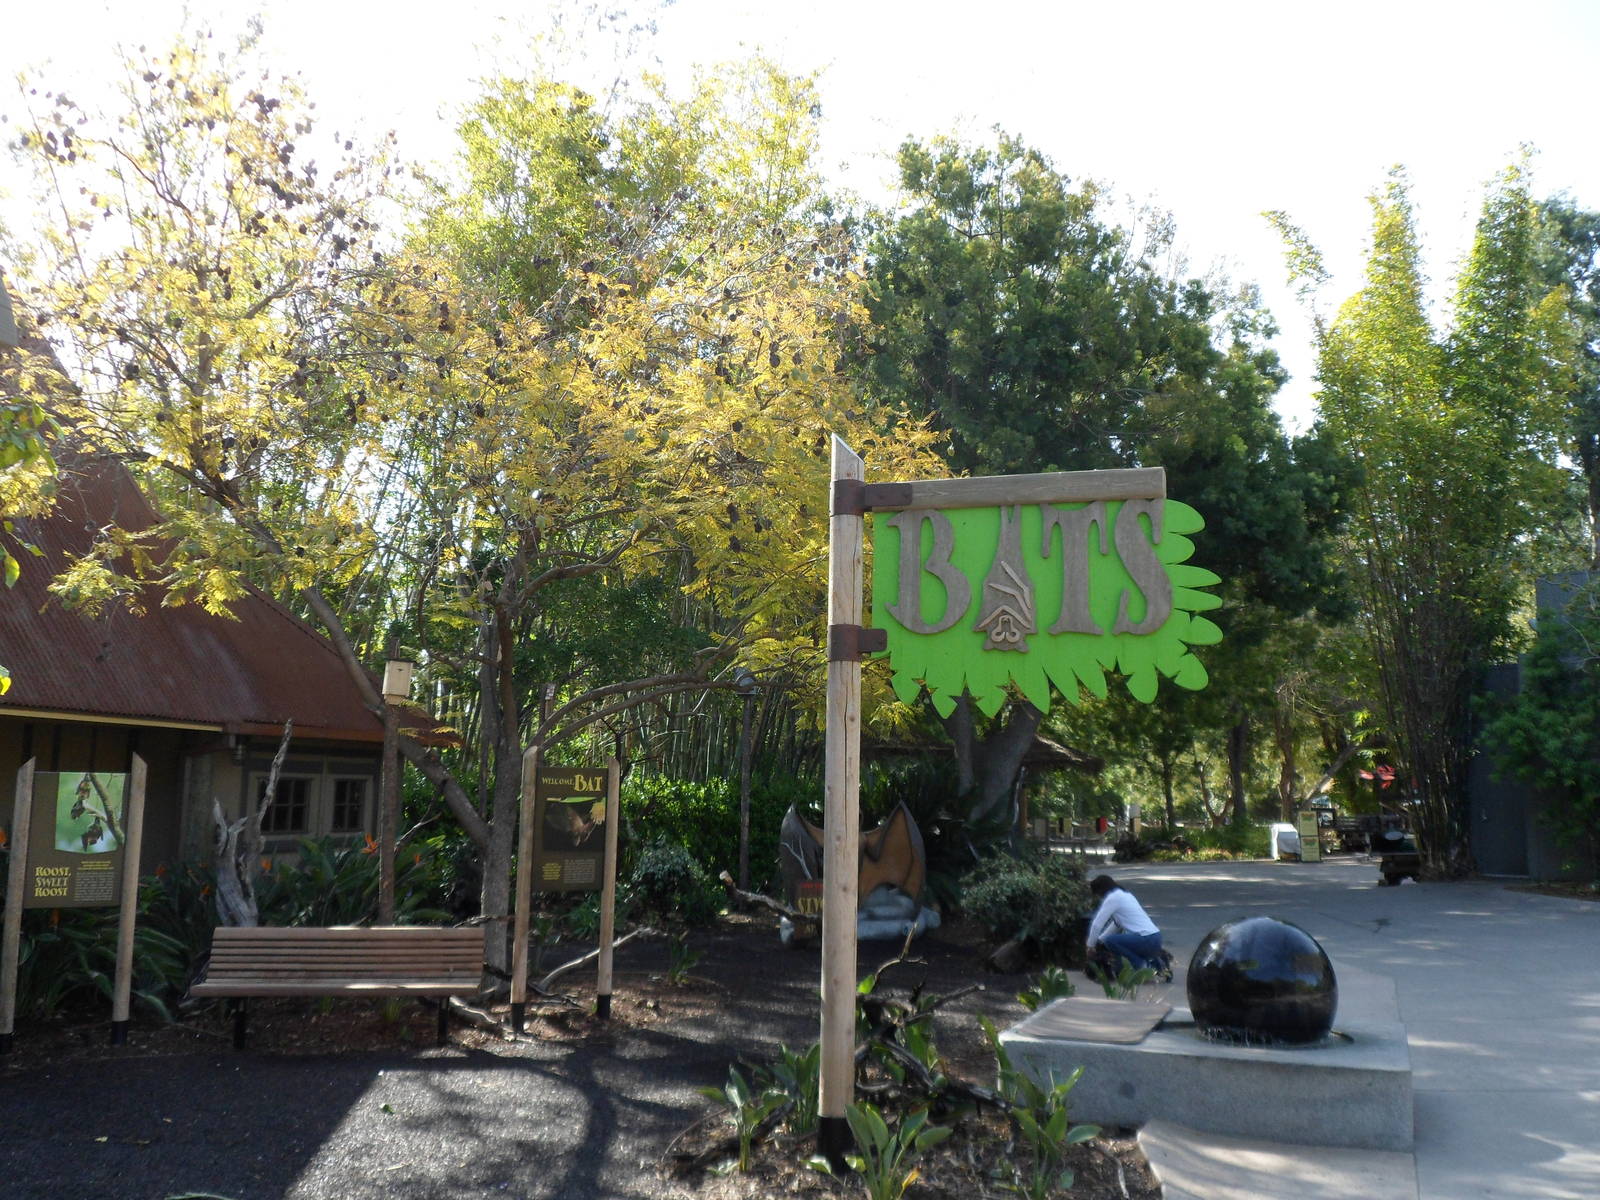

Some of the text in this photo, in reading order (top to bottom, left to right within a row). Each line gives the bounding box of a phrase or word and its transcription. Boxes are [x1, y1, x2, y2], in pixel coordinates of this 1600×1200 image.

[885, 499, 1173, 653] BATS
[574, 774, 603, 792] BAT
[35, 877, 69, 888] SWEET
[34, 887, 68, 897] ROOST
